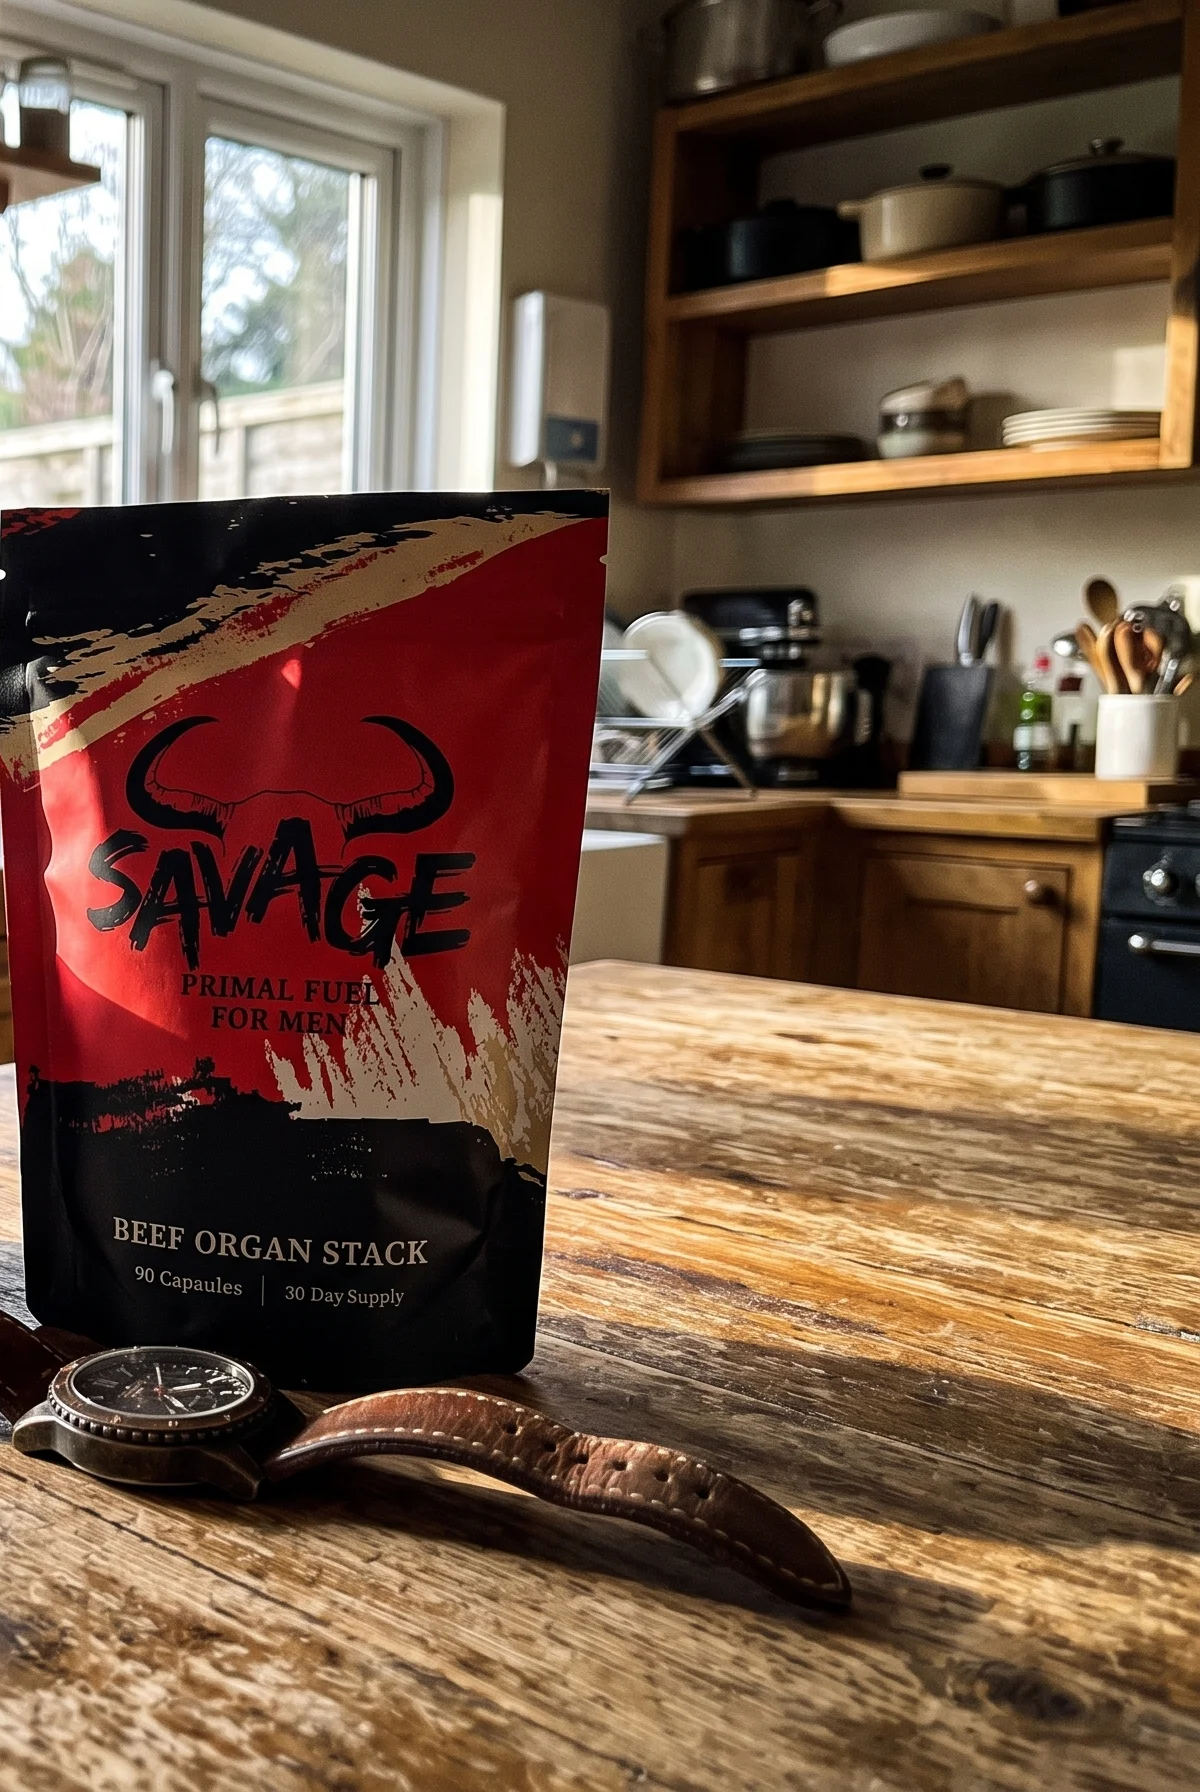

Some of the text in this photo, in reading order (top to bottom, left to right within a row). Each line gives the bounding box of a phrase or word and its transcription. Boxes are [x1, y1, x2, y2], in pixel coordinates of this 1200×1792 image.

[86, 817, 477, 971] SAVAGE
[180, 973, 380, 1006] PRIMAL FUEL
[211, 1005, 348, 1035] FOR MEN
[113, 1216, 429, 1266] BEEF ORGAN STACK
[134, 1265, 155, 1284] 90
[285, 1285, 405, 1308] 30 Day Supply
